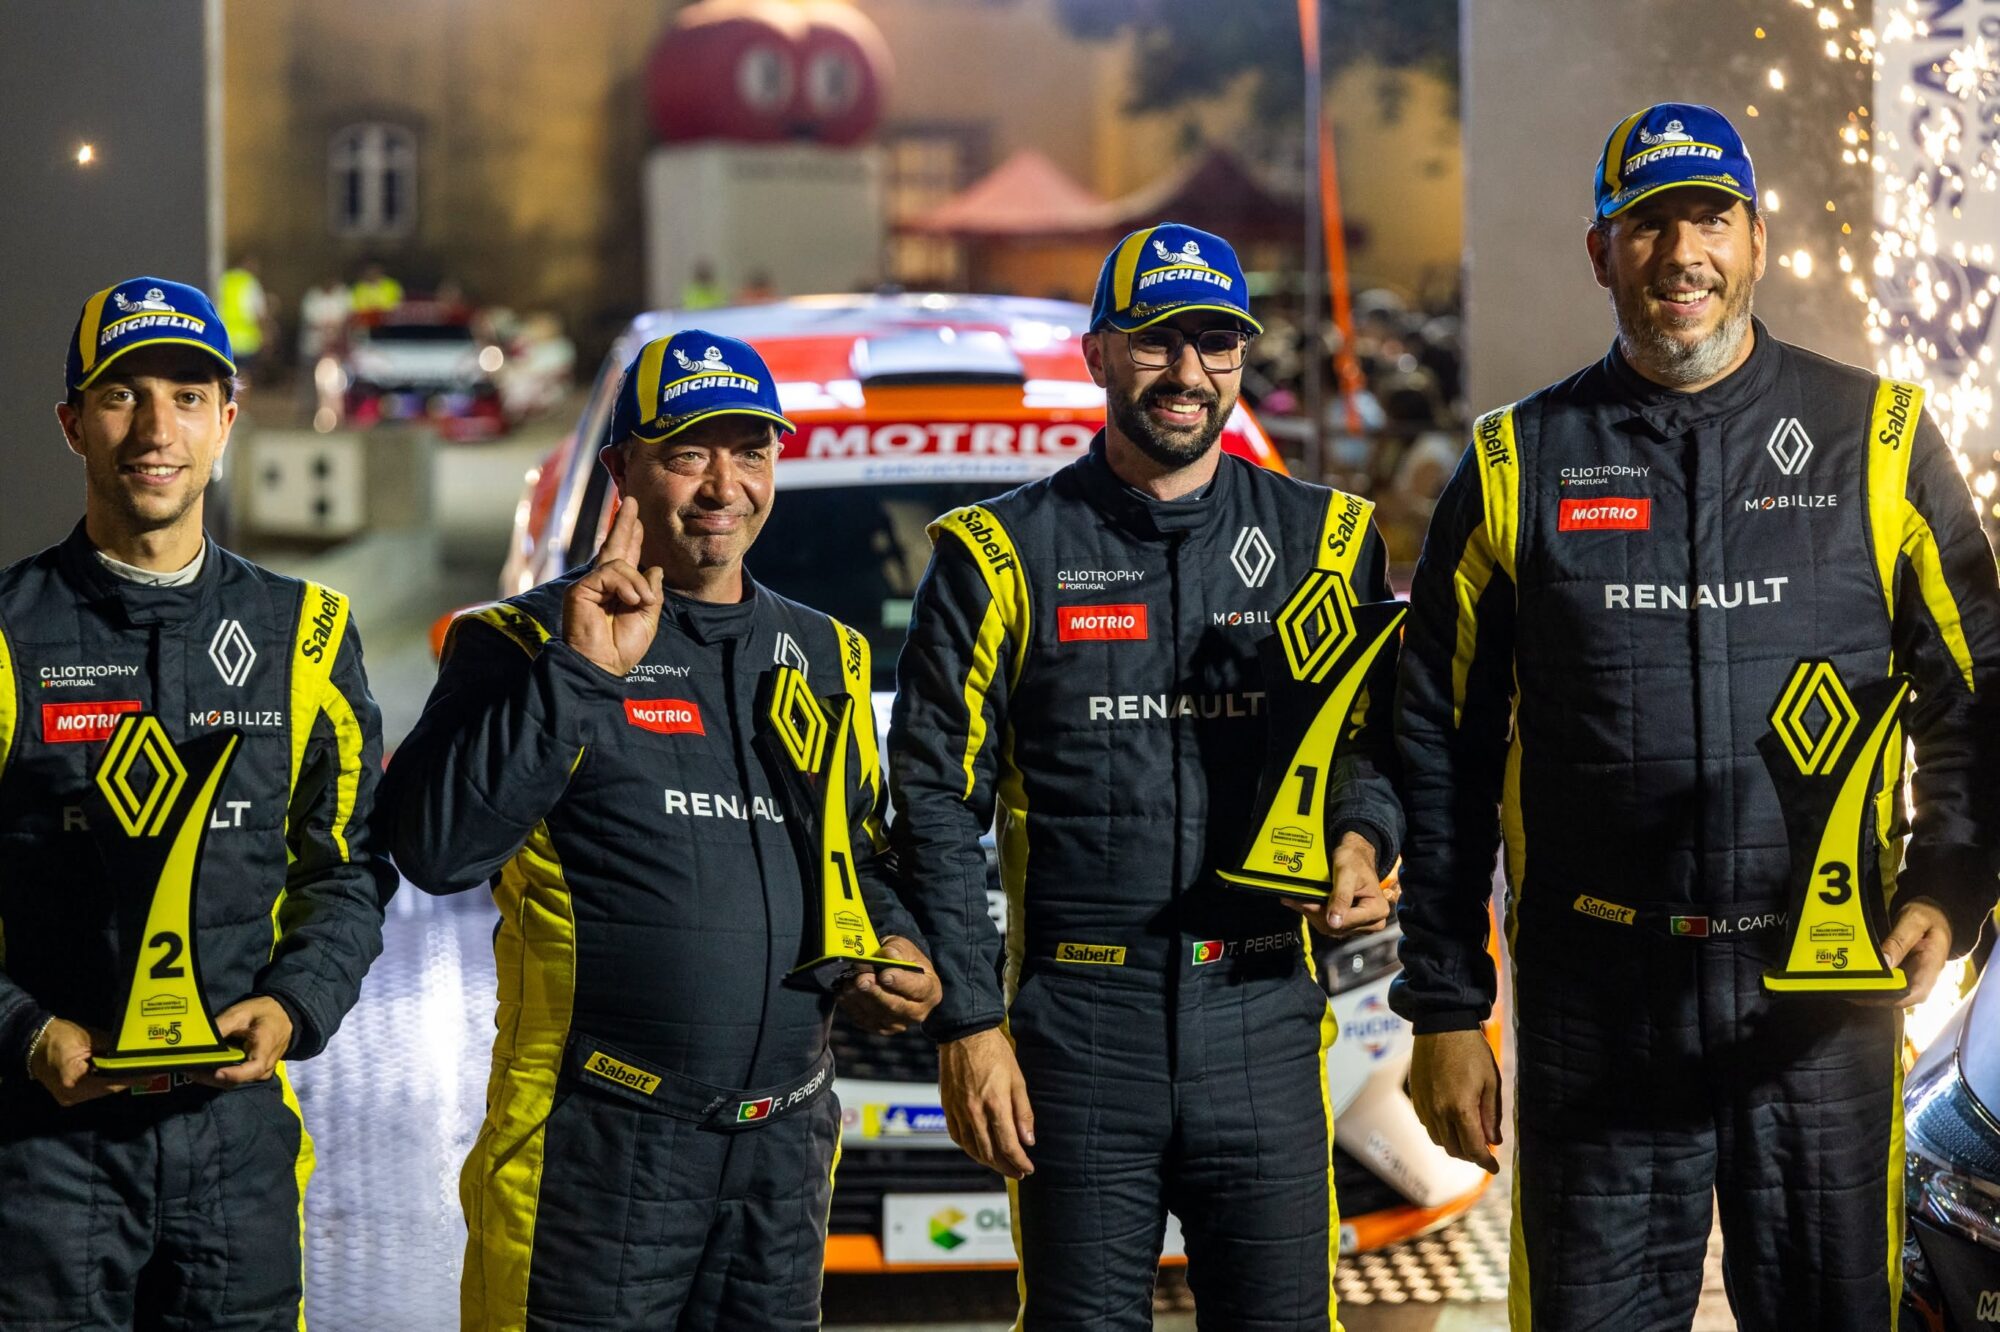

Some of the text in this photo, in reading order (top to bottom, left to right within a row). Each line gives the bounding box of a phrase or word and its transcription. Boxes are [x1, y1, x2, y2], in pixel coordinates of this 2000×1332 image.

[1624, 146, 1723, 175] MICHELIN
[1139, 268, 1232, 291] MICHELIN
[101, 315, 205, 346] MICHELIN
[663, 376, 759, 402] MICHELIN
[1879, 383, 1913, 451] Sabelt
[805, 423, 1091, 457] MOTRIO
[1560, 465, 1650, 477] CLIOTROPHY
[1569, 477, 1608, 486] PORTUGAL
[1571, 506, 1638, 521] MOTRIO
[1744, 493, 1838, 512] MOBILIZE
[1327, 494, 1363, 558] Sabelt
[958, 510, 1015, 576] Sabelt
[1057, 570, 1145, 582] CLIOTROPHY
[1065, 582, 1106, 590] PORTUGAL
[1604, 576, 1789, 609] RENAULT
[302, 588, 340, 664] Sabelt
[1070, 615, 1135, 630] MOTRIO
[1213, 611, 1270, 626] MOBIL
[40, 665, 139, 679] CLIOTROPHY
[626, 664, 691, 678] OTROPHY
[50, 679, 96, 688] PORTUGAL
[632, 708, 692, 723] MOTRIO
[1089, 691, 1266, 721] RENAULT
[190, 710, 283, 727] MOBILIZE
[1294, 764, 1318, 816] 1
[664, 788, 785, 824] RENAU
[831, 850, 854, 900] 1
[1818, 861, 1852, 905] 3
[1579, 898, 1632, 922] Sabelt
[1712, 911, 1790, 933] M. CARV
[148, 931, 185, 979] 2
[1064, 944, 1118, 963] Sabelt
[594, 1057, 653, 1093] Sabelt
[772, 1097, 783, 1113] F.
